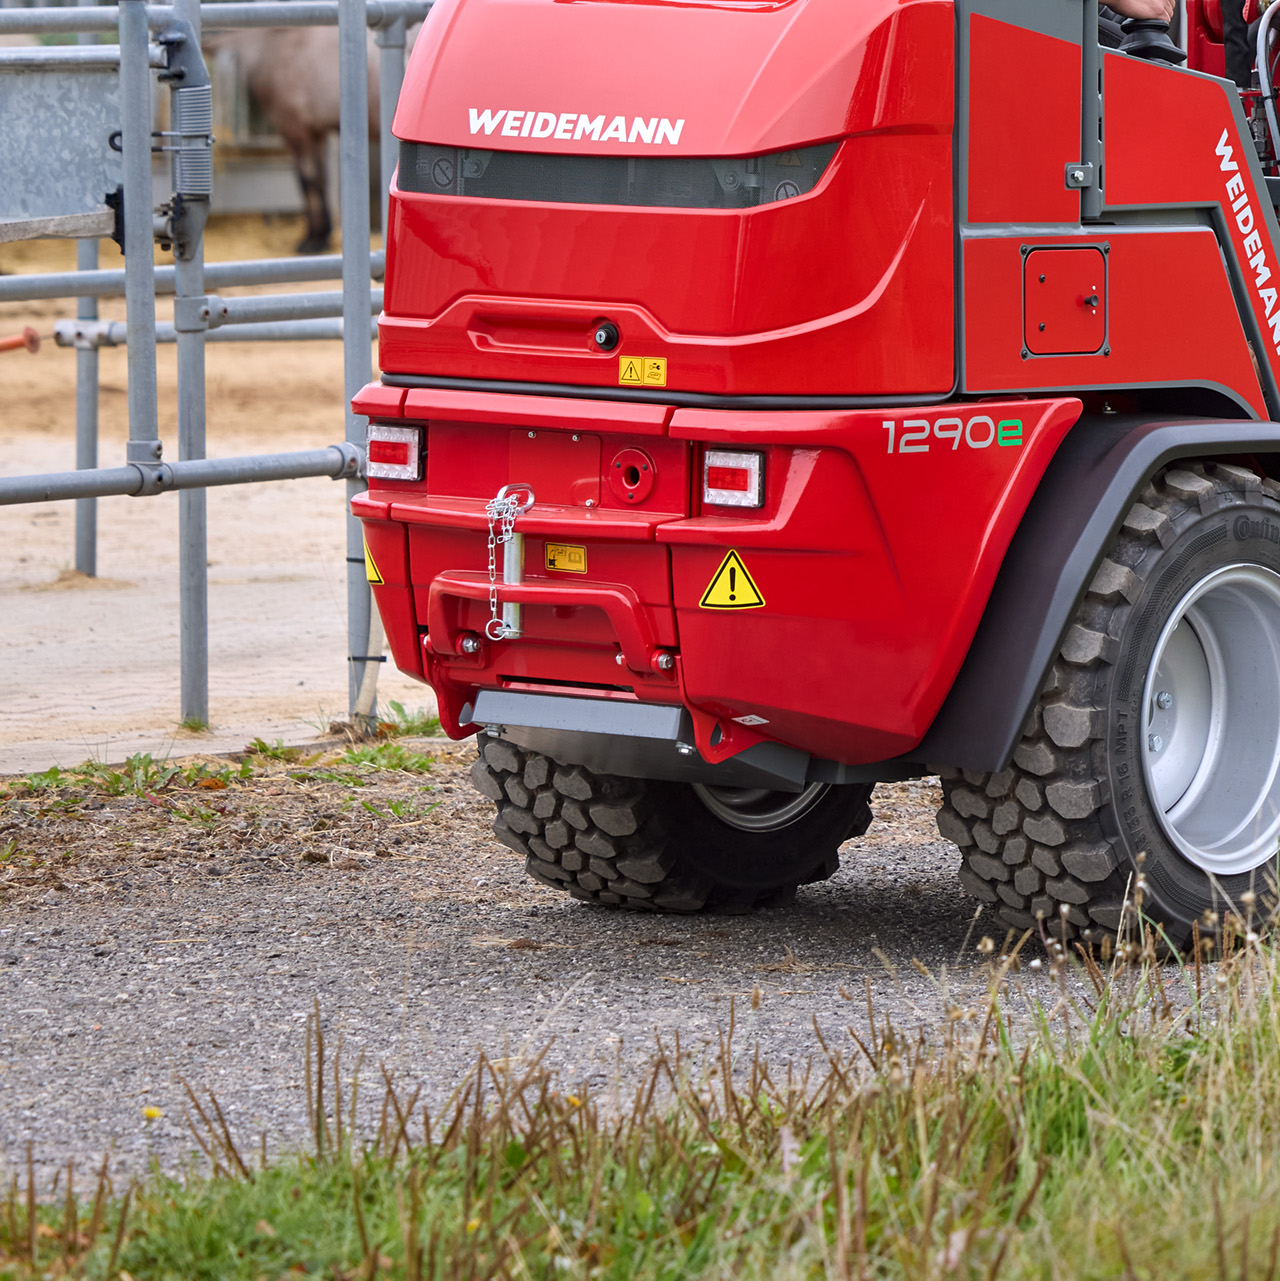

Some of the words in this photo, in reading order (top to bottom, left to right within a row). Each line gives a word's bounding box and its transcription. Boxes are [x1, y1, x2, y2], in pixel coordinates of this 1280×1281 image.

[468, 108, 686, 146] WEIDEMANN
[882, 415, 1023, 454] 1290e
[1116, 709, 1128, 754] MPT
[1117, 761, 1130, 785] 16
[1121, 785, 1133, 802] R
